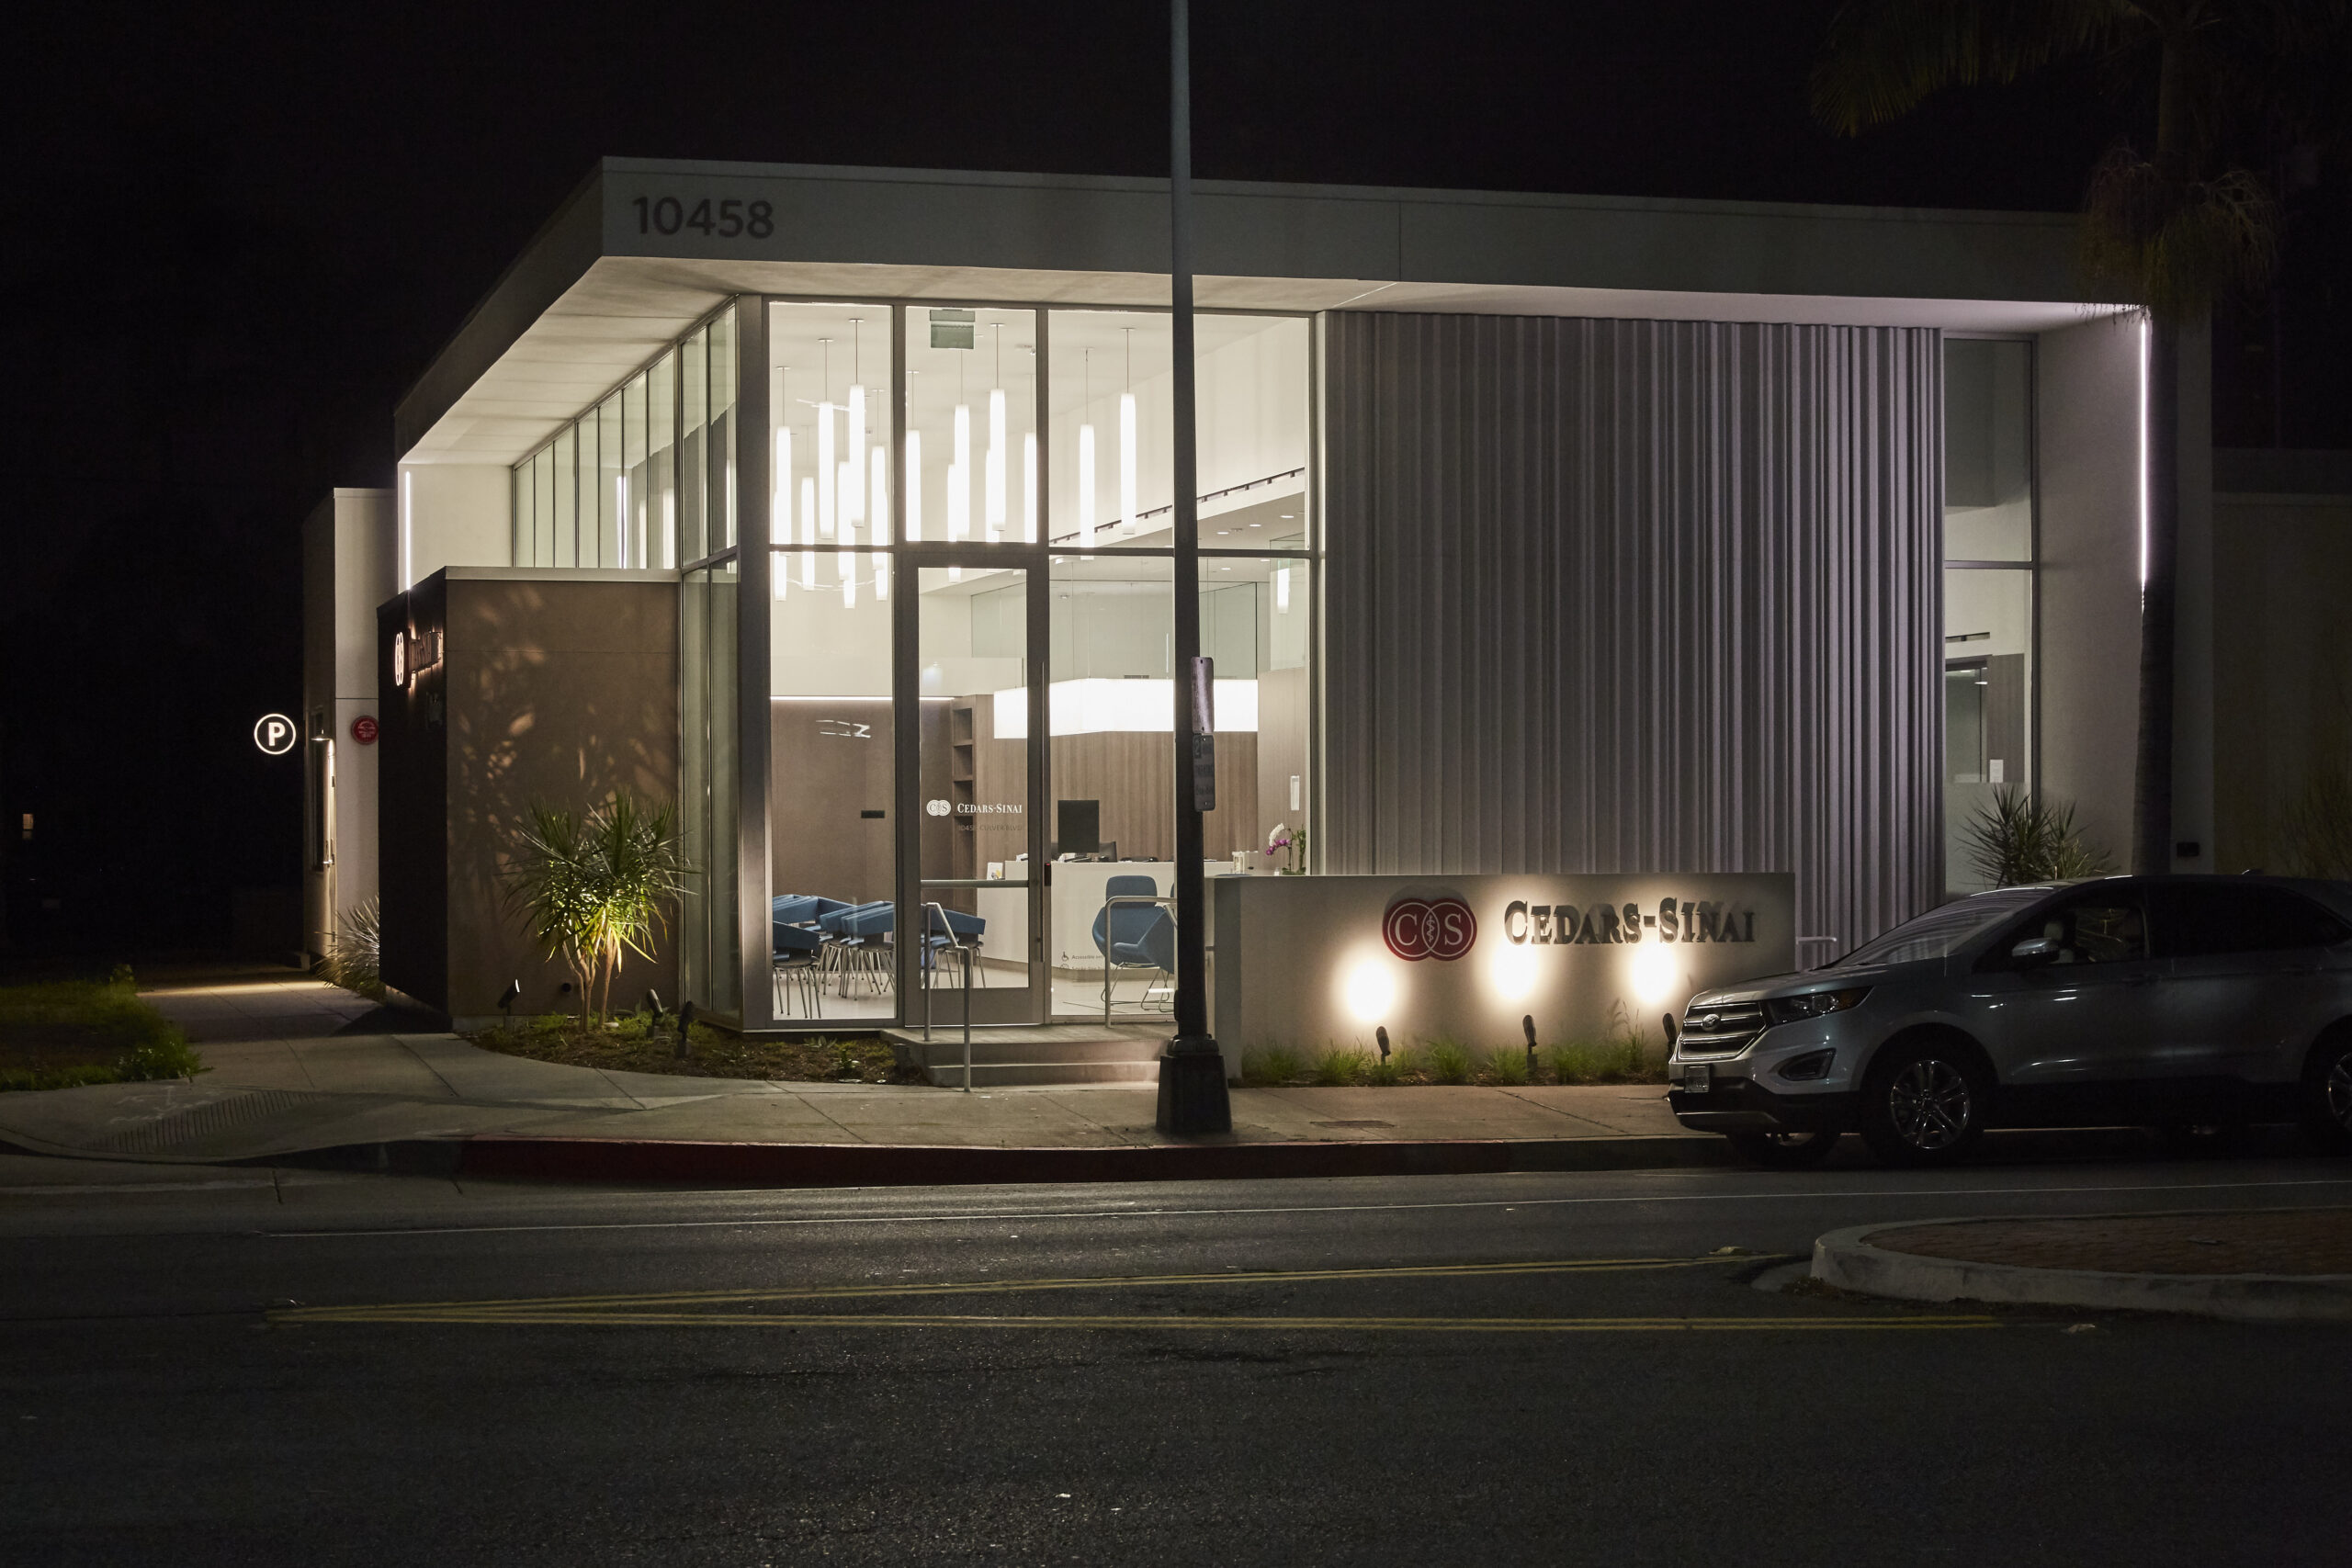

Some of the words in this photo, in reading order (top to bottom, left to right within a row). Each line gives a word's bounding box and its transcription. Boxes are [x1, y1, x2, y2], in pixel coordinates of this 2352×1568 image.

[632, 197, 775, 239] 10458
[268, 722, 286, 747] P
[957, 803, 1023, 814] CEDARS-SINAI
[1504, 899, 1755, 945] CEDARS-SINAI
